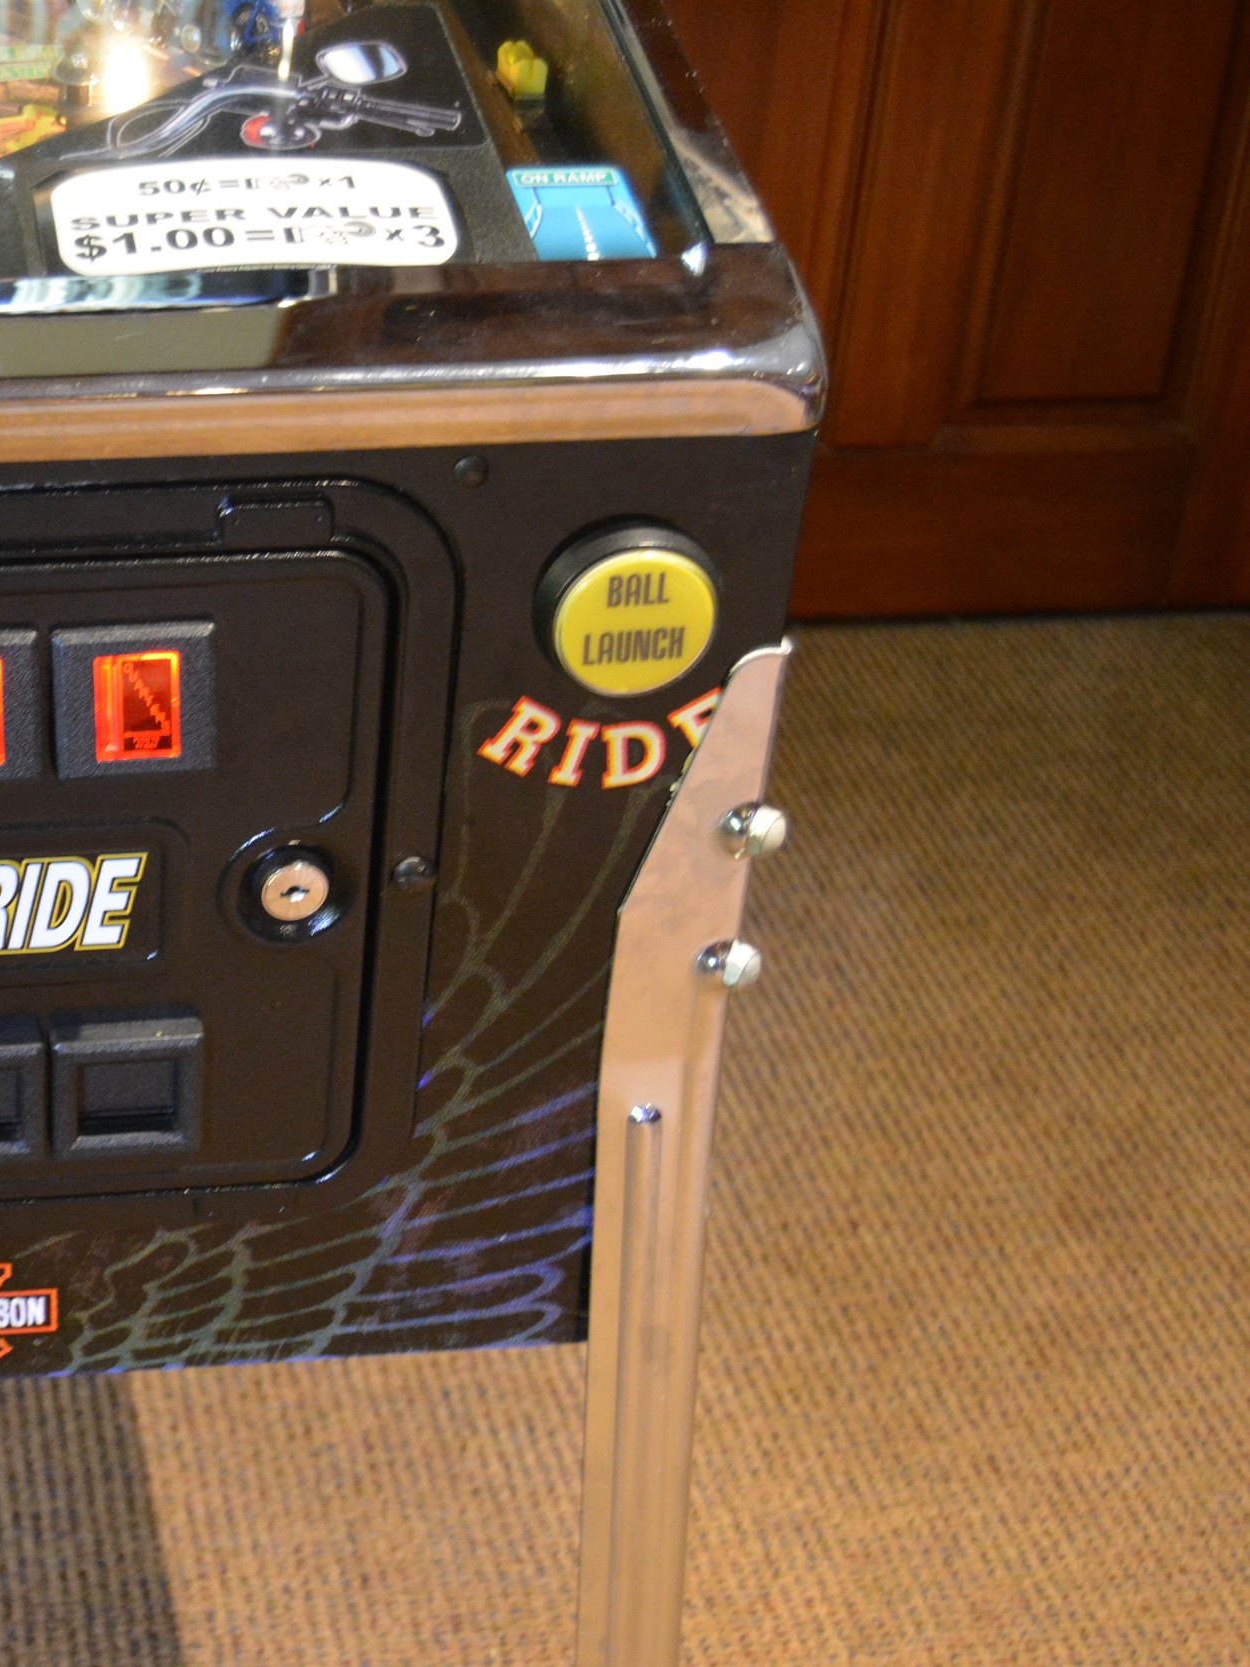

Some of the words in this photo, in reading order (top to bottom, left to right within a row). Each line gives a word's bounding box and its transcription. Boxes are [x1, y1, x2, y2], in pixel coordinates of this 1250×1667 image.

[520, 172, 549, 185] ON
[553, 171, 608, 184] RAMP
[71, 208, 247, 231] SUPER
[267, 206, 438, 220] VALUE
[605, 571, 671, 609] BALL
[581, 626, 686, 667] LAUNCH
